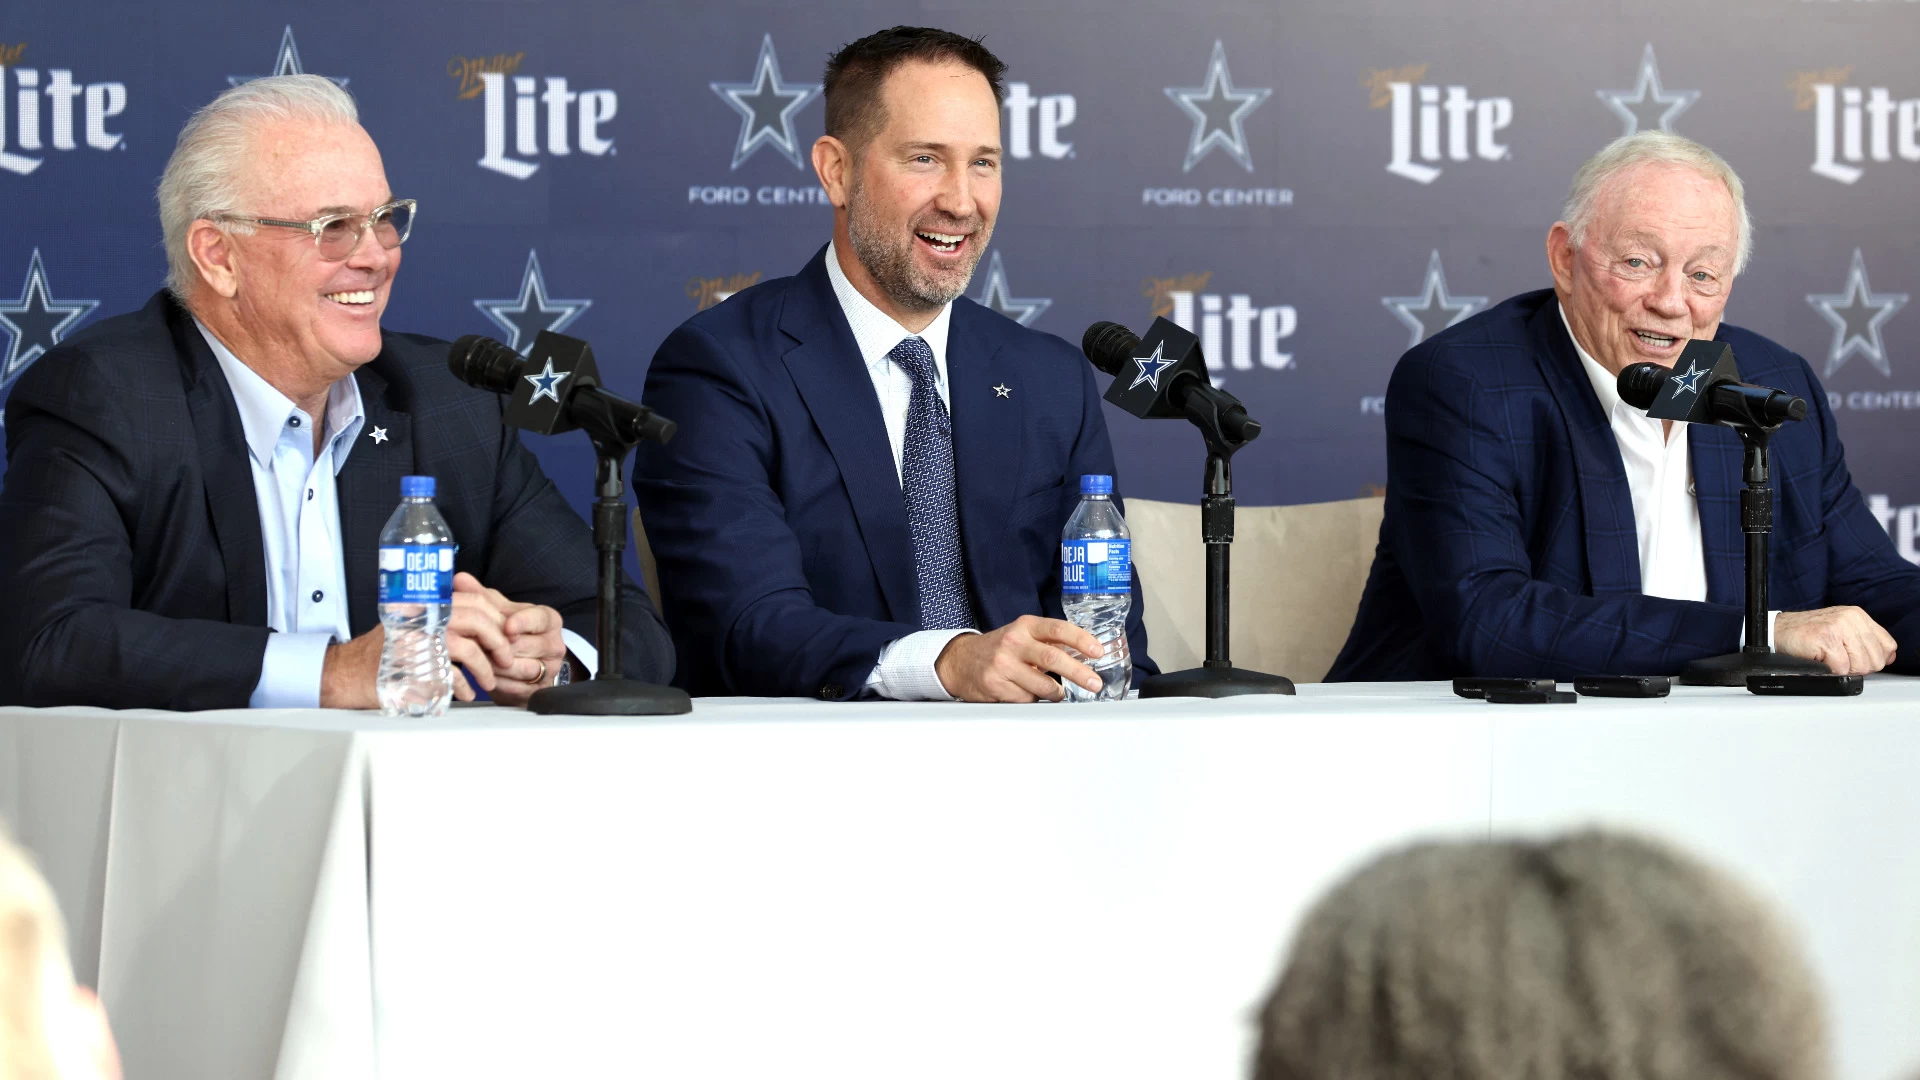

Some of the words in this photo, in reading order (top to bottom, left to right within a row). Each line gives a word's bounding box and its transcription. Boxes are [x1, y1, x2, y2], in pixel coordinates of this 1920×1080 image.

[477, 72, 618, 180] Lite
[1003, 82, 1077, 159] te
[1385, 82, 1513, 184] Lite
[688, 186, 750, 205] FORD
[756, 186, 831, 205] CENTE
[1142, 188, 1201, 207] FORD
[1207, 188, 1294, 207] CENTER
[406, 552, 438, 572] DEJA
[1064, 546, 1085, 563] DEJA
[406, 571, 438, 591] BLUE
[1063, 564, 1085, 582] BLUE
